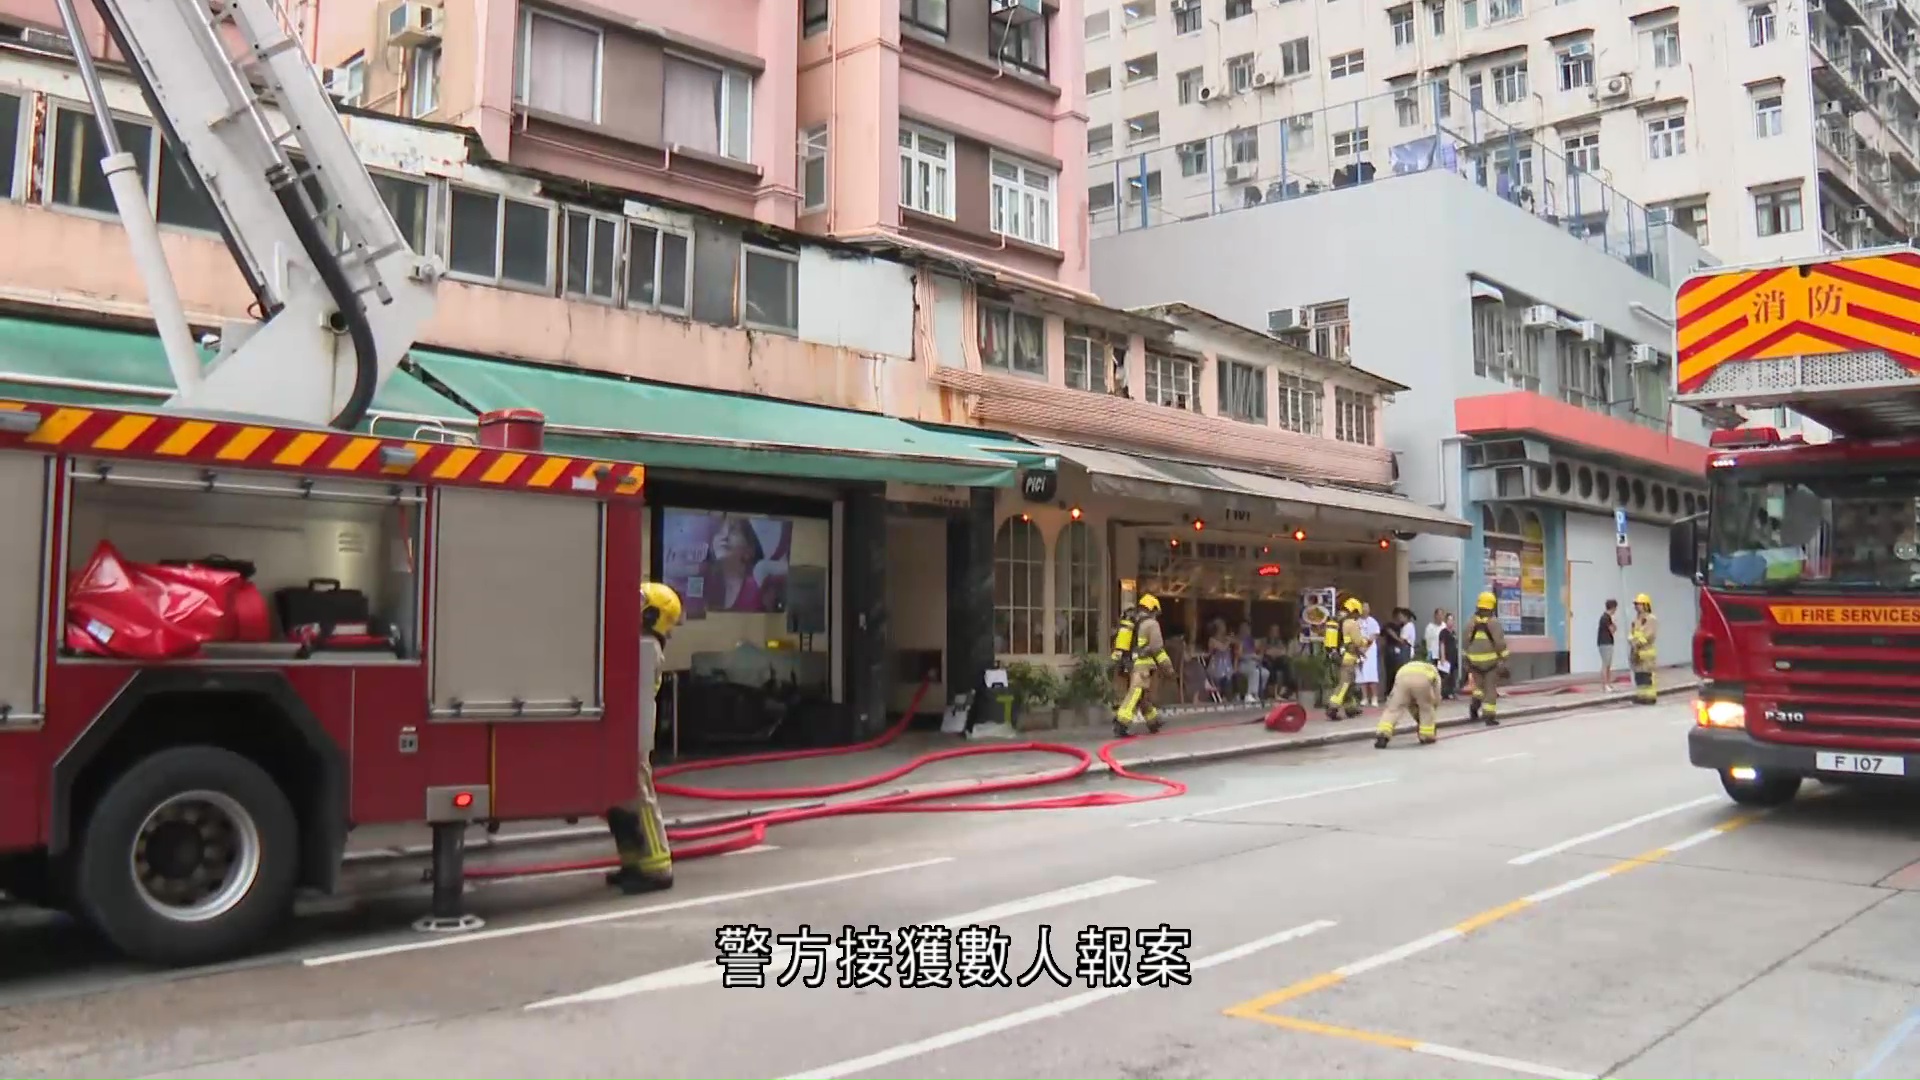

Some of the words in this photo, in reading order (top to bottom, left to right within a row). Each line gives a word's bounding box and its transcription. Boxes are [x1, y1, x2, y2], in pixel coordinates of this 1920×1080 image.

[1752, 284, 1844, 324] 消防
[1801, 608, 1836, 622] FIRE
[1841, 608, 1920, 623] SERVICES
[1835, 755, 1846, 769] F
[1853, 757, 1884, 772] 107
